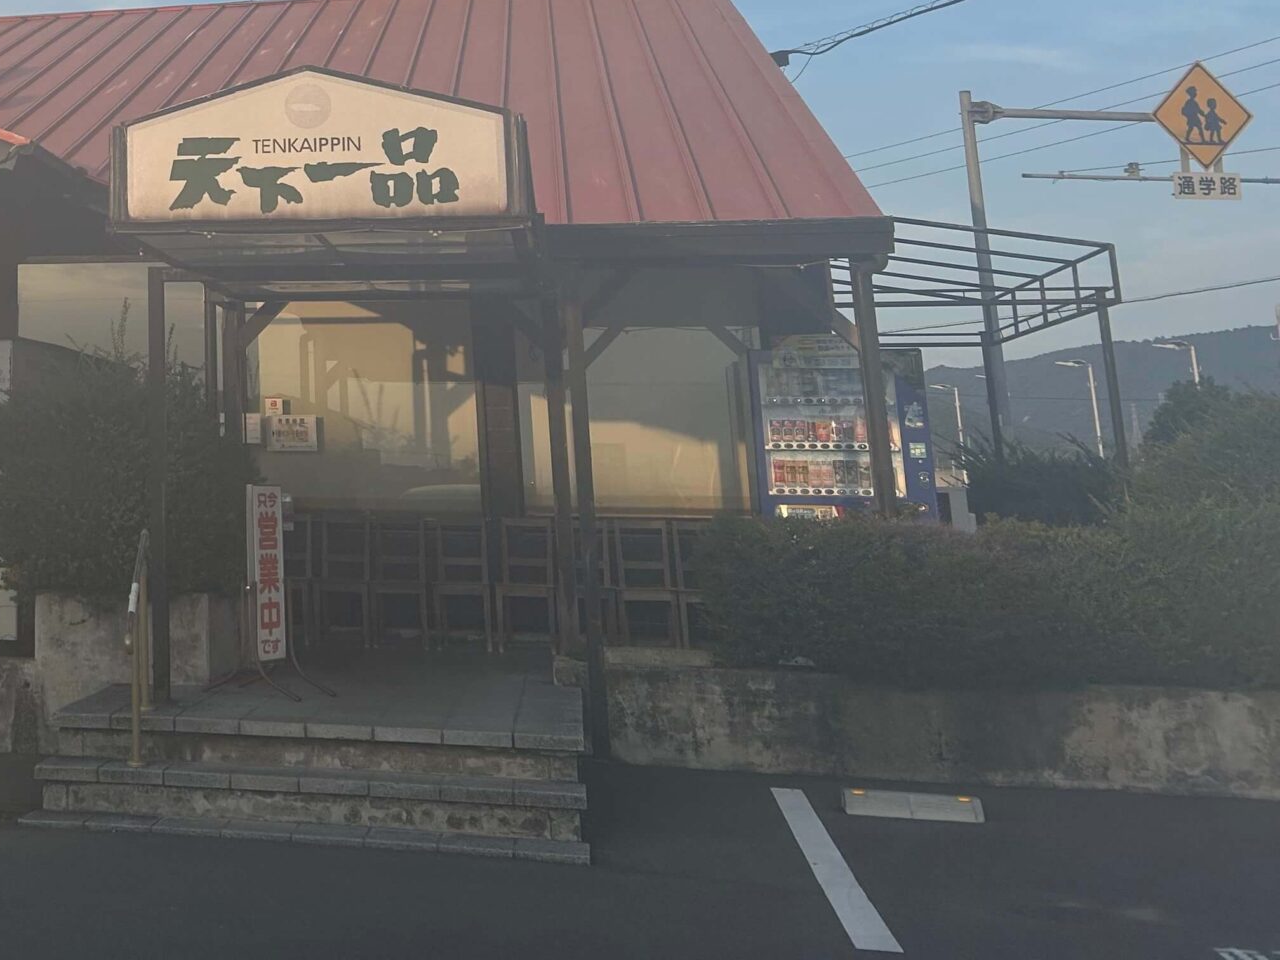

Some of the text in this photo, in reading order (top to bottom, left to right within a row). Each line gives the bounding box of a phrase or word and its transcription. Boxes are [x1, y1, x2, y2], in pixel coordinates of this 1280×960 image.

[252, 136, 362, 155] TENKAIPPIN
[168, 126, 461, 214] 天下一品
[1177, 175, 1238, 196] 通学路
